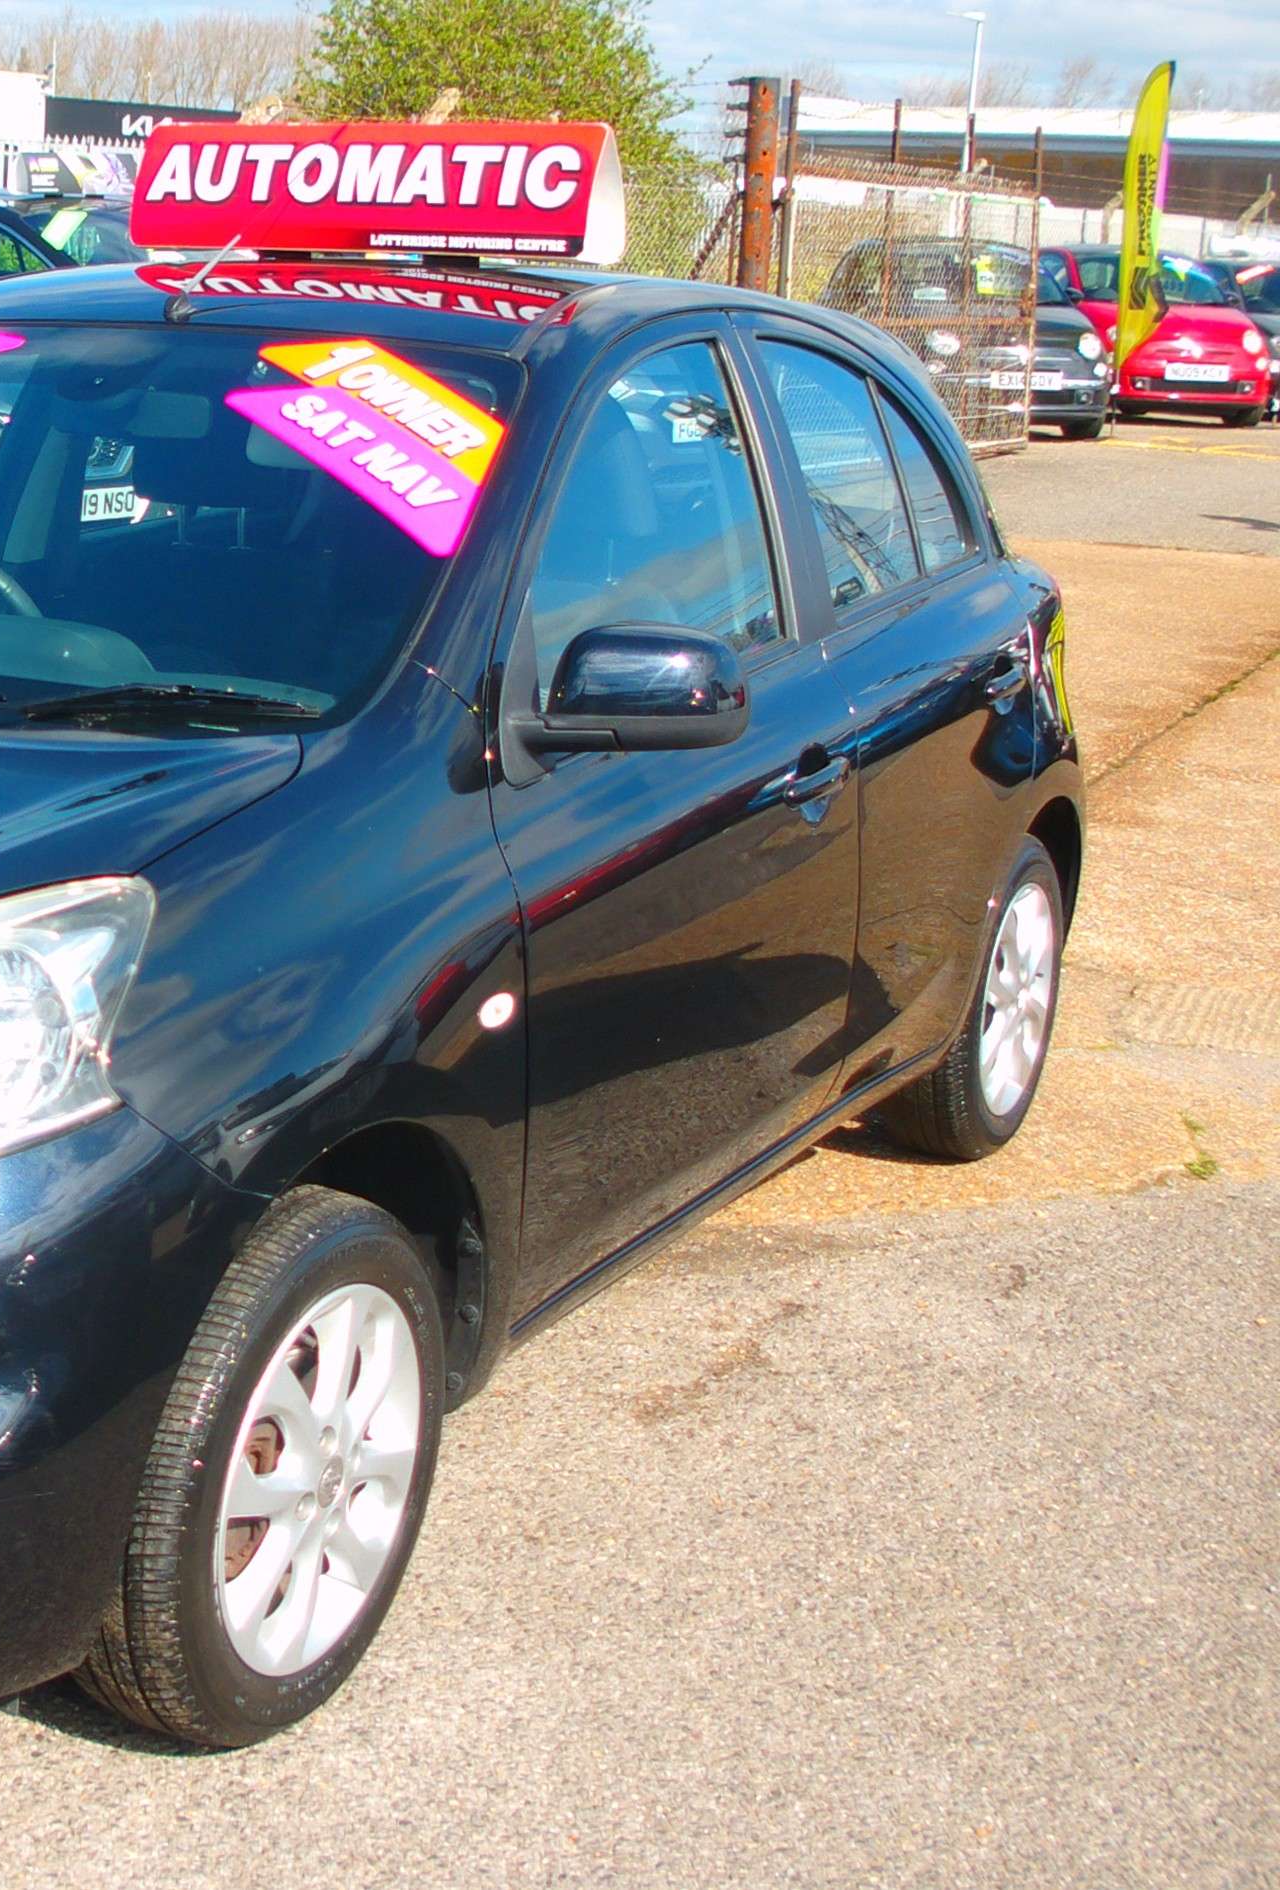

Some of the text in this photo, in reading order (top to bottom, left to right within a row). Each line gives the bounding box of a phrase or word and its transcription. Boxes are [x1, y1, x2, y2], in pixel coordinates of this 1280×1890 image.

[145, 142, 582, 211] AUTOMATIC
[370, 233, 568, 252] LOTTBRIDGE MOTORING CENTRE
[303, 347, 488, 458] 1 OWNER
[280, 395, 461, 509] SAT NAV
